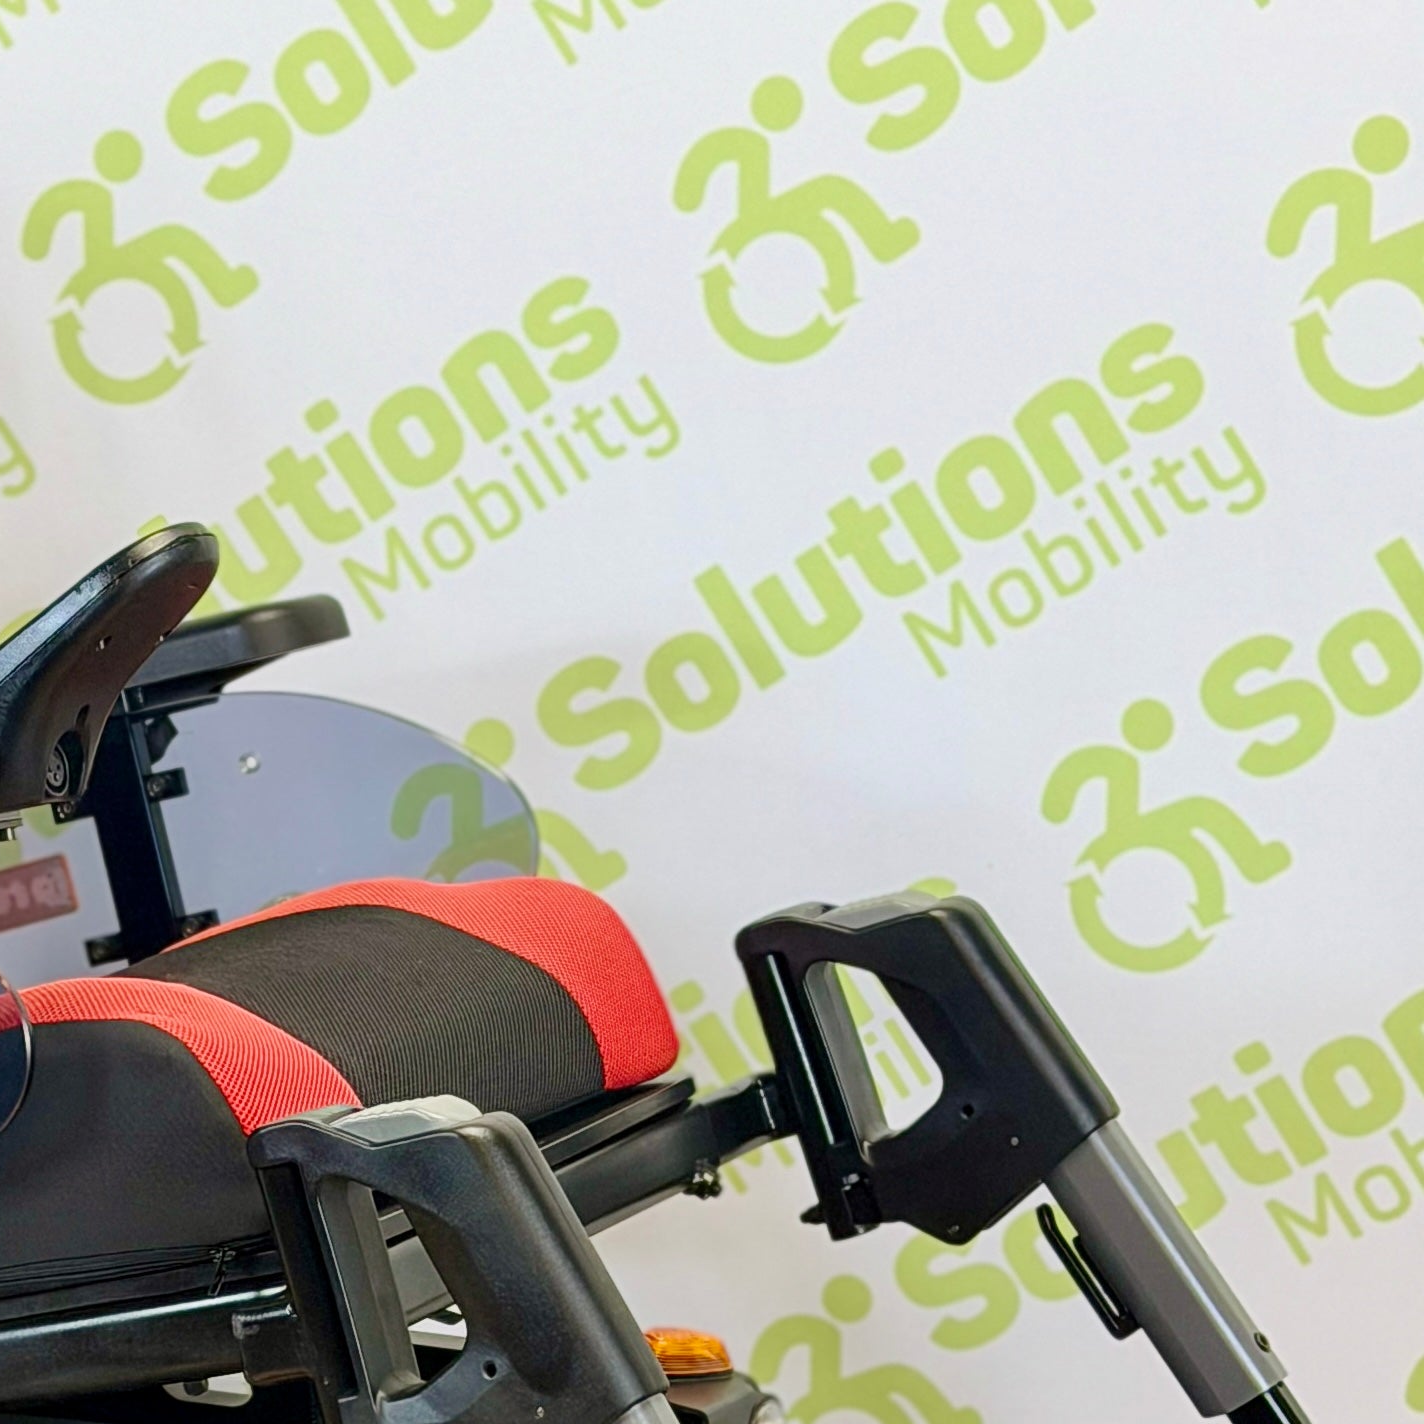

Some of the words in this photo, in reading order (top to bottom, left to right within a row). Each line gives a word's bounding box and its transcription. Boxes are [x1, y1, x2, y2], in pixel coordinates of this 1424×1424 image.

[341, 375, 680, 621] Mobility
[535, 322, 1205, 791] Solutions
[902, 426, 1267, 678] Mobility
